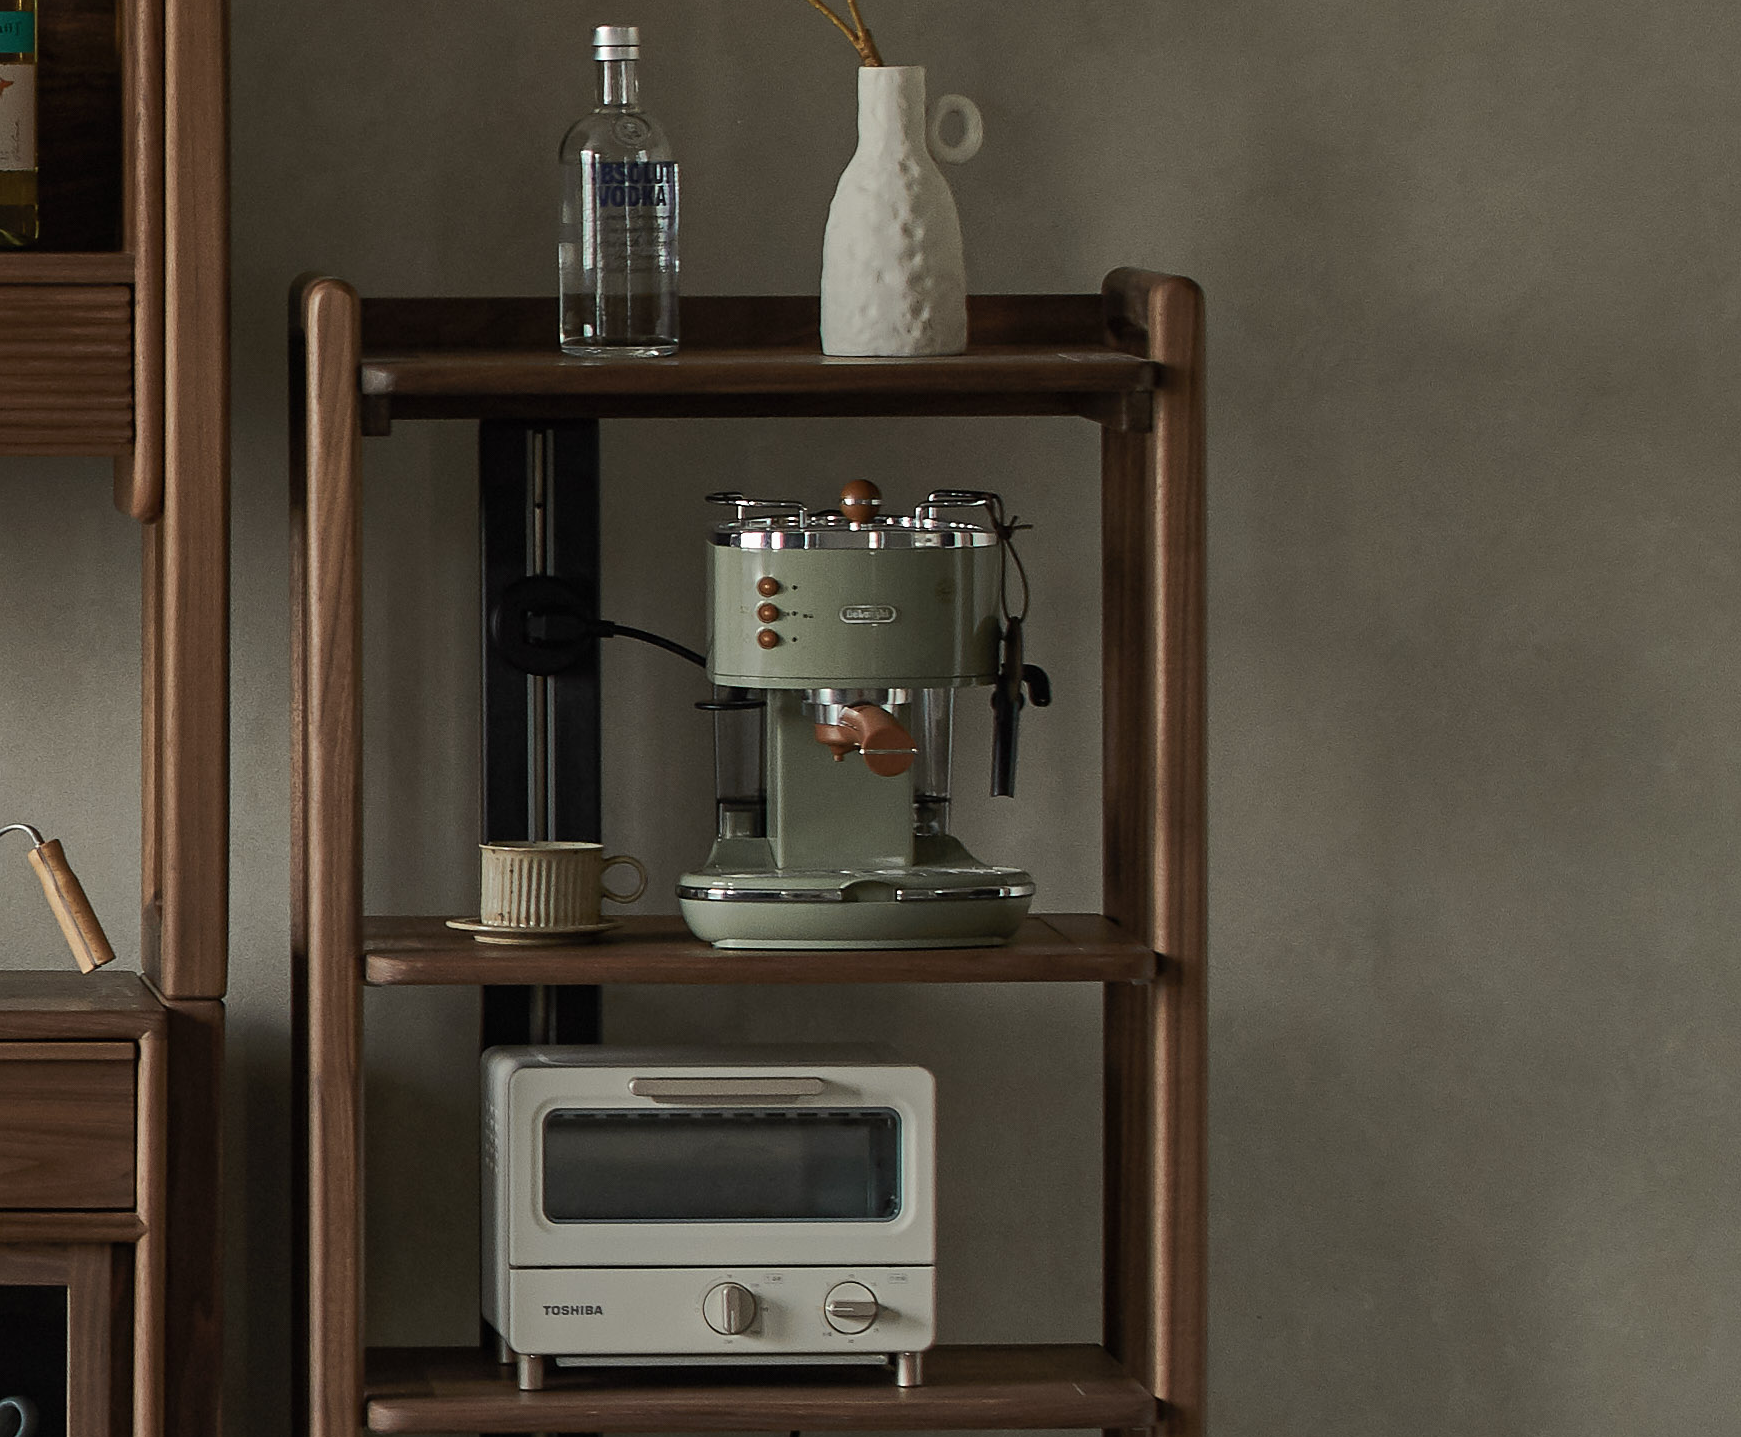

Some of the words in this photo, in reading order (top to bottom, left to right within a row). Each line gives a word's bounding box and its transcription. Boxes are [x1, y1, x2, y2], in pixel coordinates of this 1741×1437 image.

[594, 162, 674, 184] BSOLUT
[598, 185, 667, 208] VODKA
[542, 1305, 604, 1316] TOSHIBA
